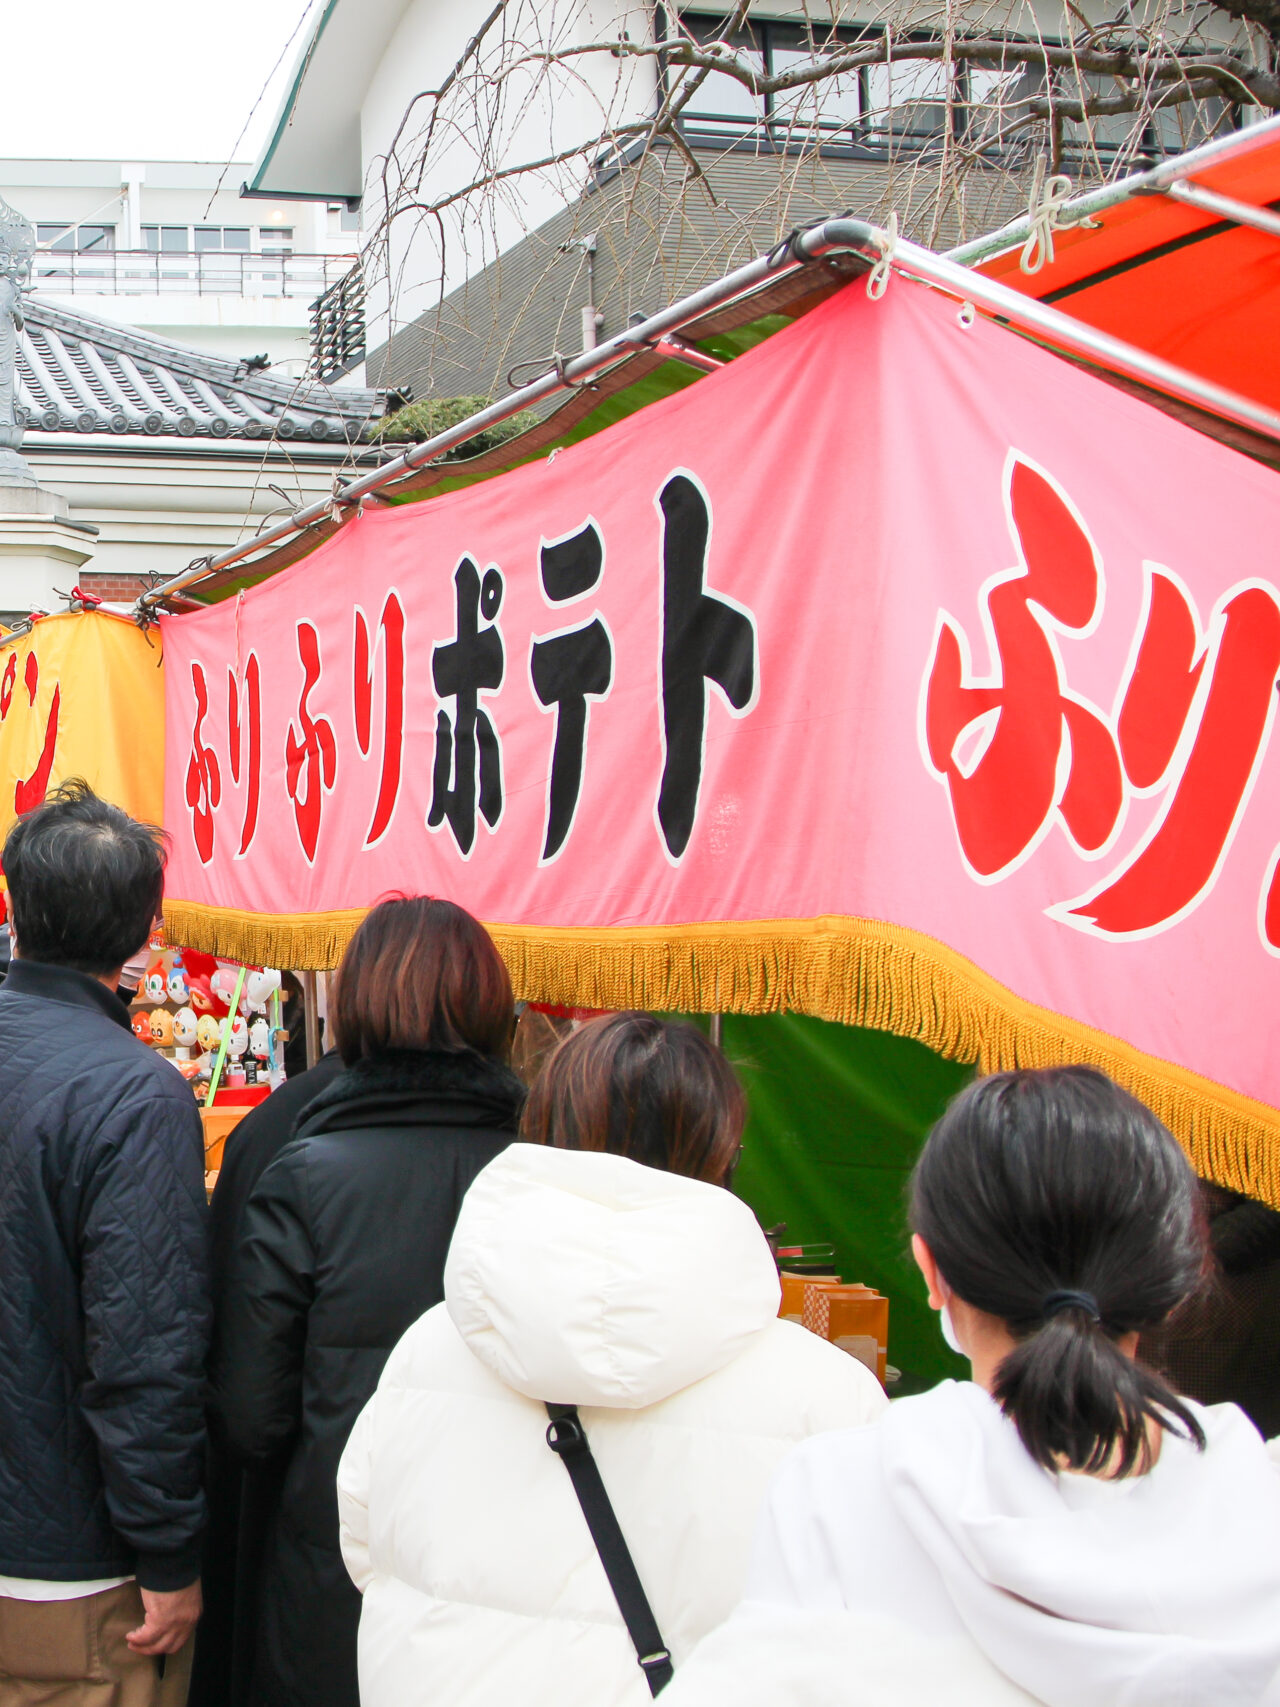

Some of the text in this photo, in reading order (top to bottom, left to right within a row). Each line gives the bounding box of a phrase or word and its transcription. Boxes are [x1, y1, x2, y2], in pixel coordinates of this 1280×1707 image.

[185, 467, 760, 867] ふりふりポテト
[917, 447, 1280, 958] ふり
